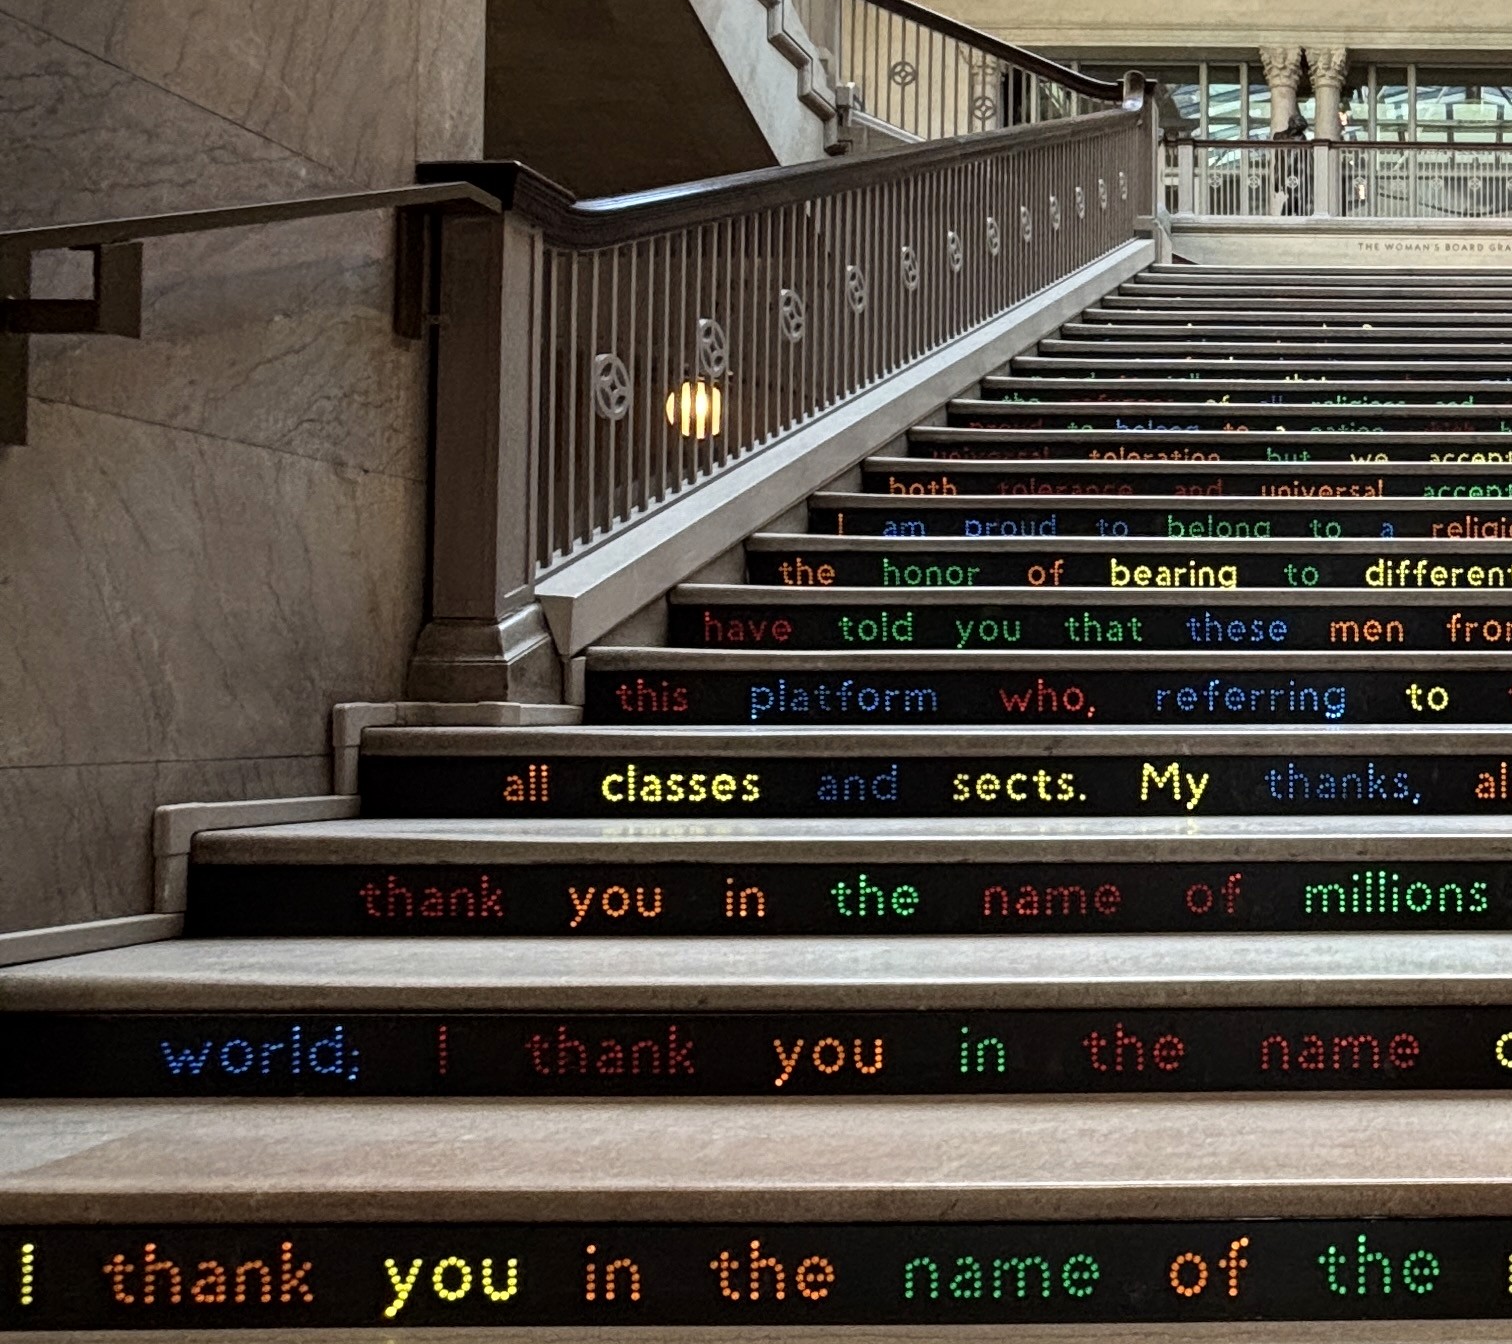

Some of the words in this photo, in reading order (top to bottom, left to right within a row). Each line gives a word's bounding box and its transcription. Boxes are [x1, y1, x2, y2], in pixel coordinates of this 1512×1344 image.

[1358, 243, 1380, 251] THE
[1445, 243, 1484, 252] BOARD
[836, 511, 845, 536] I
[882, 519, 927, 538] am
[963, 516, 1057, 537] proud
[1097, 518, 1132, 538] to
[1167, 514, 1272, 538] belong
[1310, 519, 1344, 539] to
[1380, 521, 1396, 538] a
[779, 557, 836, 587] the
[882, 558, 978, 588] honor
[1026, 559, 1064, 588] of
[1109, 560, 1238, 589] bearing
[1283, 563, 1321, 588] to
[703, 609, 794, 643] have
[839, 611, 914, 642] told
[955, 619, 1022, 649] you
[1065, 611, 1142, 643] that
[1187, 612, 1290, 643] these
[1329, 618, 1405, 643] men
[614, 677, 689, 713] this
[750, 678, 938, 721] platform
[1000, 677, 1097, 719] who,
[1154, 678, 1347, 722] referring
[1405, 682, 1450, 712] to
[502, 763, 550, 802] all
[600, 763, 760, 803] classes
[816, 762, 900, 802] and
[952, 769, 1084, 802] sects.
[1140, 762, 1209, 810] My
[1264, 762, 1422, 805] thanks,
[358, 873, 505, 919] thank
[569, 884, 663, 928] you
[725, 878, 766, 918] in
[831, 873, 919, 917] the
[982, 883, 1121, 918] name
[1184, 871, 1244, 915] of
[1304, 869, 1488, 913] millions
[161, 1024, 360, 1082] world;
[435, 1023, 449, 1076] I
[524, 1023, 696, 1076] thank
[773, 1036, 884, 1088] you
[959, 1026, 1006, 1073] in
[1082, 1023, 1185, 1073] the
[1260, 1031, 1421, 1072] name
[19, 1243, 34, 1306] I
[102, 1240, 314, 1305] thank
[382, 1256, 518, 1320] you
[585, 1243, 641, 1302] in
[709, 1239, 836, 1302] the
[904, 1253, 1101, 1300] name
[1168, 1236, 1250, 1298] of
[1317, 1233, 1441, 1296] the
